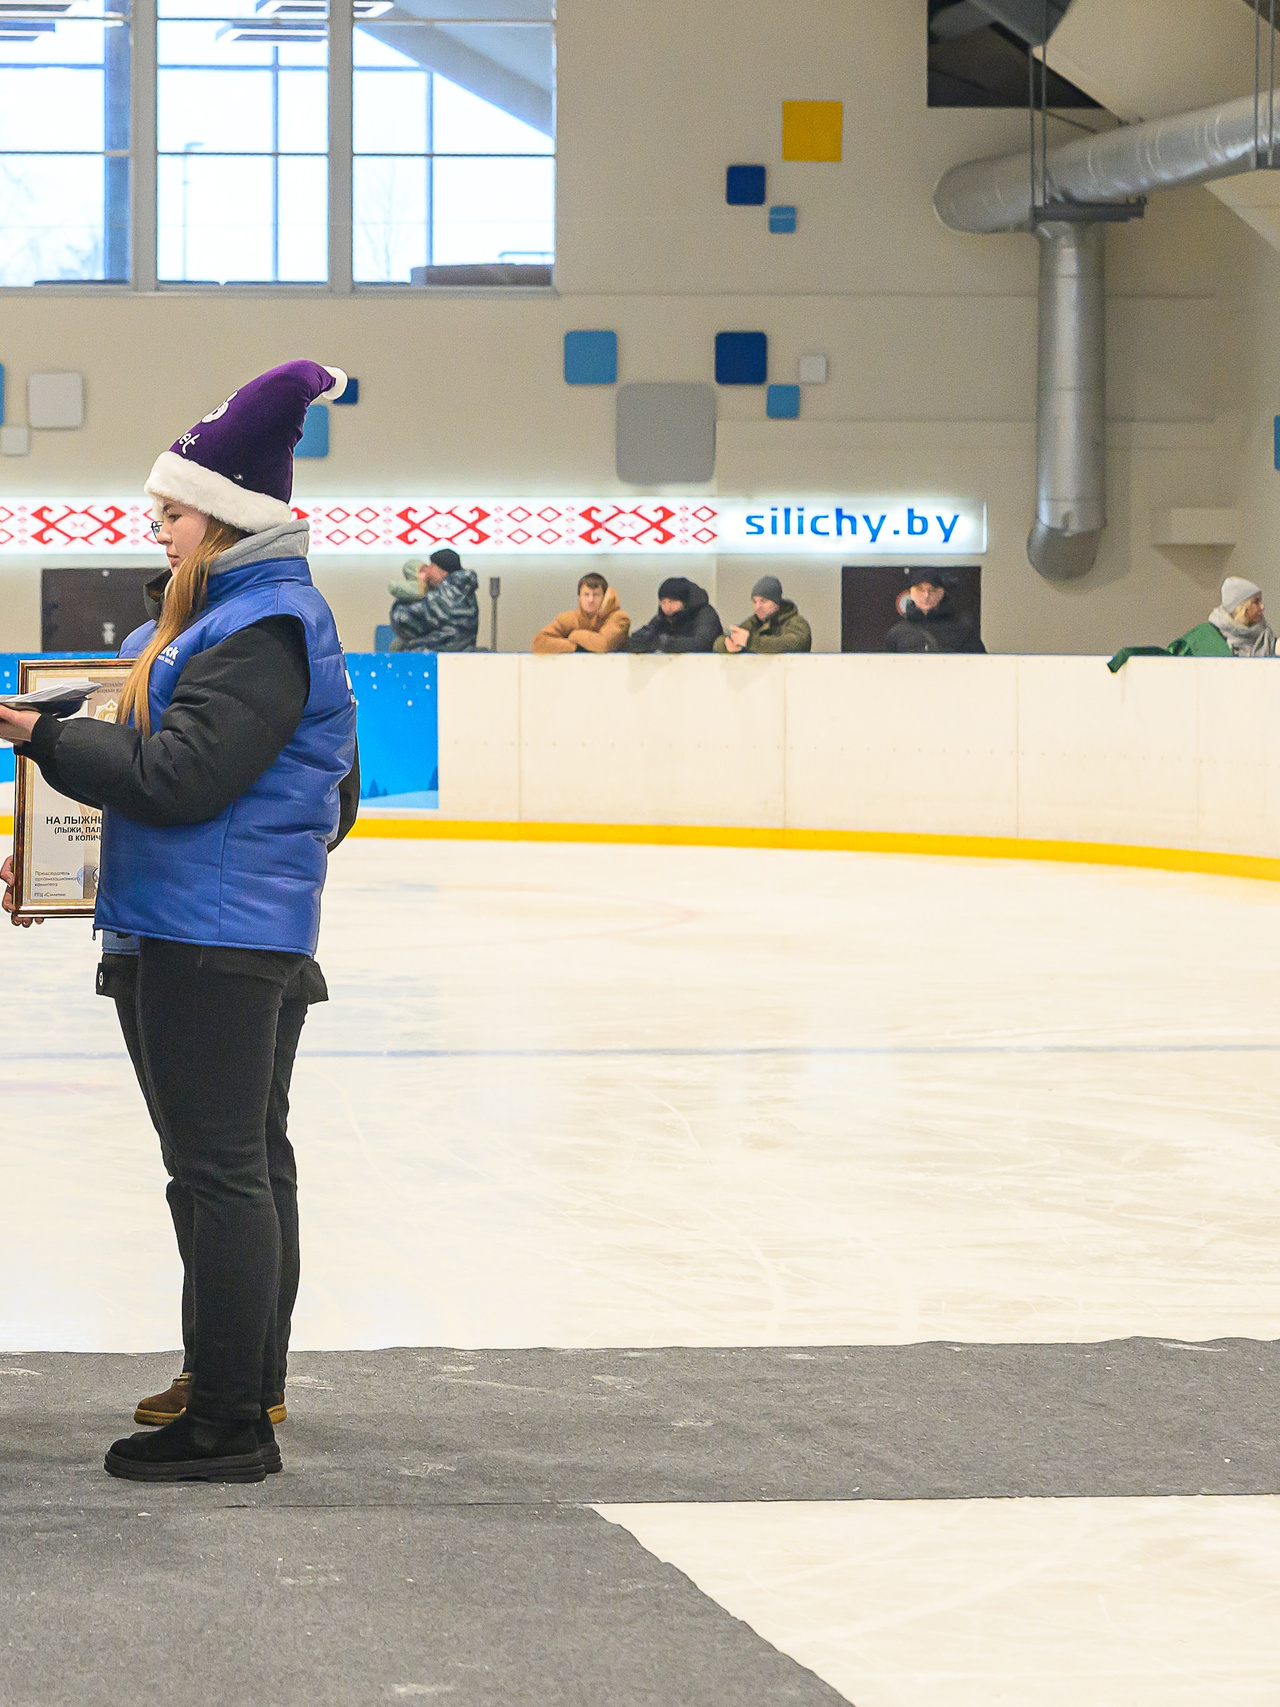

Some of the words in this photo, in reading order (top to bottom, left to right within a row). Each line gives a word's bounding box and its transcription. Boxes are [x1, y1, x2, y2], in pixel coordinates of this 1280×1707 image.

[745, 507, 961, 544] silichy.by
[45, 816, 61, 825] НА
[54, 826, 84, 835] (ЛЫЖИ,
